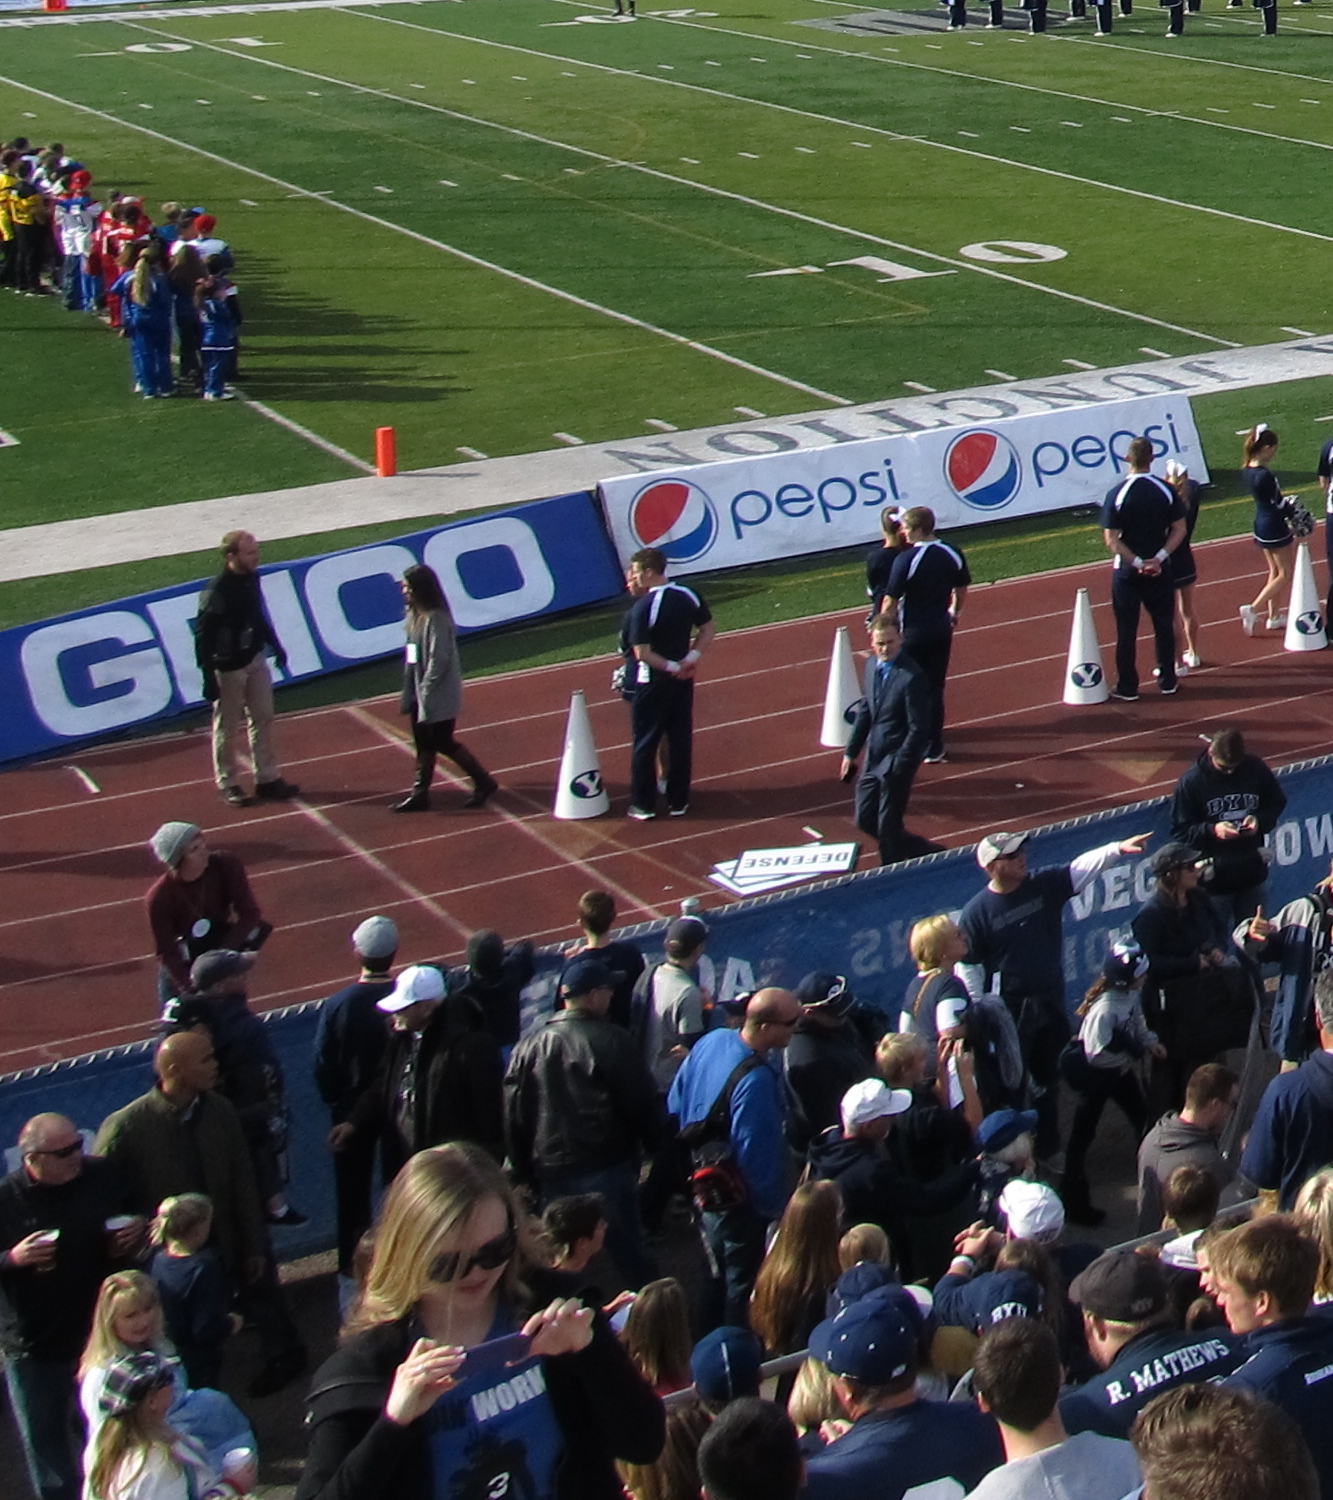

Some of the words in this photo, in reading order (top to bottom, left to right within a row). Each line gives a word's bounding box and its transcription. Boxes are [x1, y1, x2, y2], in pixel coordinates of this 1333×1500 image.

[824, 240, 1068, 283] 10
[729, 457, 900, 542] pepsi
[1206, 793, 1261, 817] BYU
[742, 851, 851, 869] DEFENSE
[1068, 864, 1158, 922] VEG
[1105, 1380, 1132, 1405] R.
[1129, 1338, 1231, 1394] MATHEWS
[487, 1471, 510, 1499] 3
